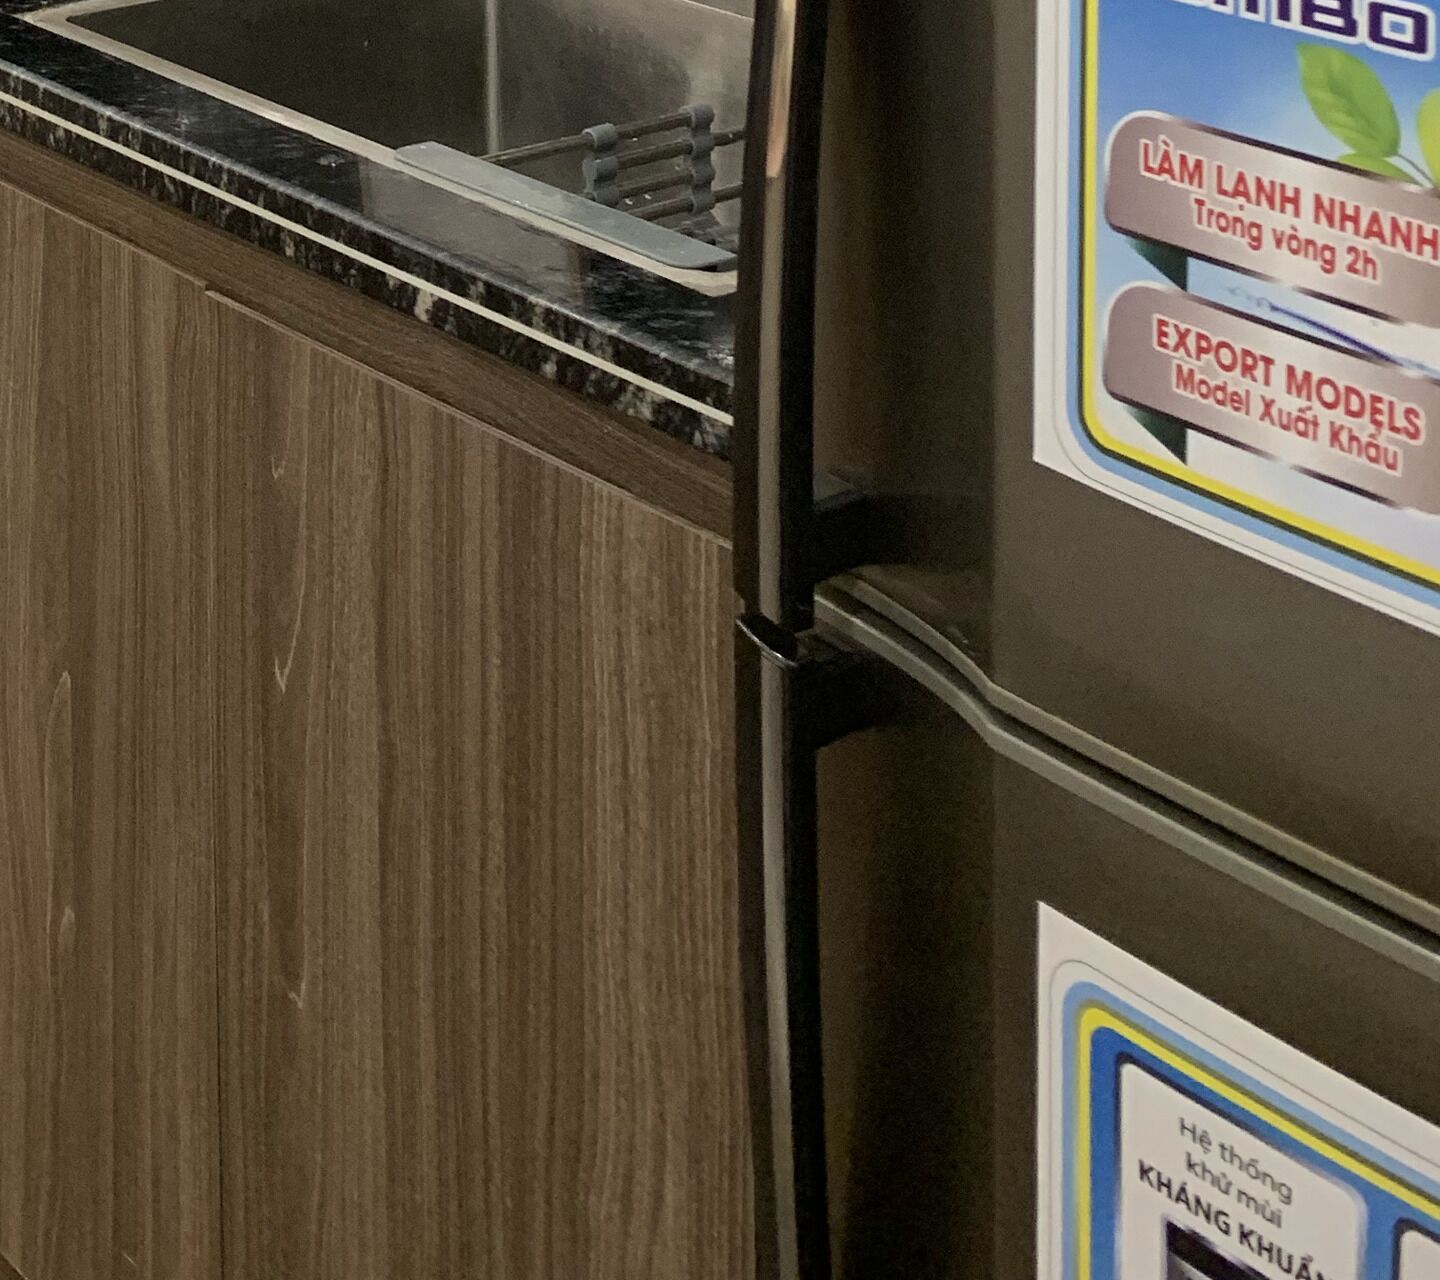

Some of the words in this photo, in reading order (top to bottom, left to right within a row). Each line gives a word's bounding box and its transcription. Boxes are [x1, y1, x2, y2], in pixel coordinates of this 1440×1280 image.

[1142, 139, 1204, 189] LÀM
[1216, 165, 1302, 219] LẠNH
[1313, 193, 1439, 261] NHANH
[1194, 197, 1264, 252] Trong
[1271, 225, 1337, 275] vòng
[1346, 246, 1378, 281] 2h
[1156, 318, 1276, 387] EXPORT
[1285, 364, 1422, 441] MODELS
[1175, 363, 1251, 416] Model
[1259, 395, 1320, 442] Xuất
[1329, 421, 1399, 472] Khẩu
[1180, 1117, 1212, 1154] Hệ
[1219, 1142, 1293, 1205] thống
[1186, 1152, 1233, 1196] khử
[1237, 1189, 1282, 1229] mùi
[1138, 1158, 1232, 1237] KHÁNG
[1239, 1222, 1333, 1280] KHUẨ
